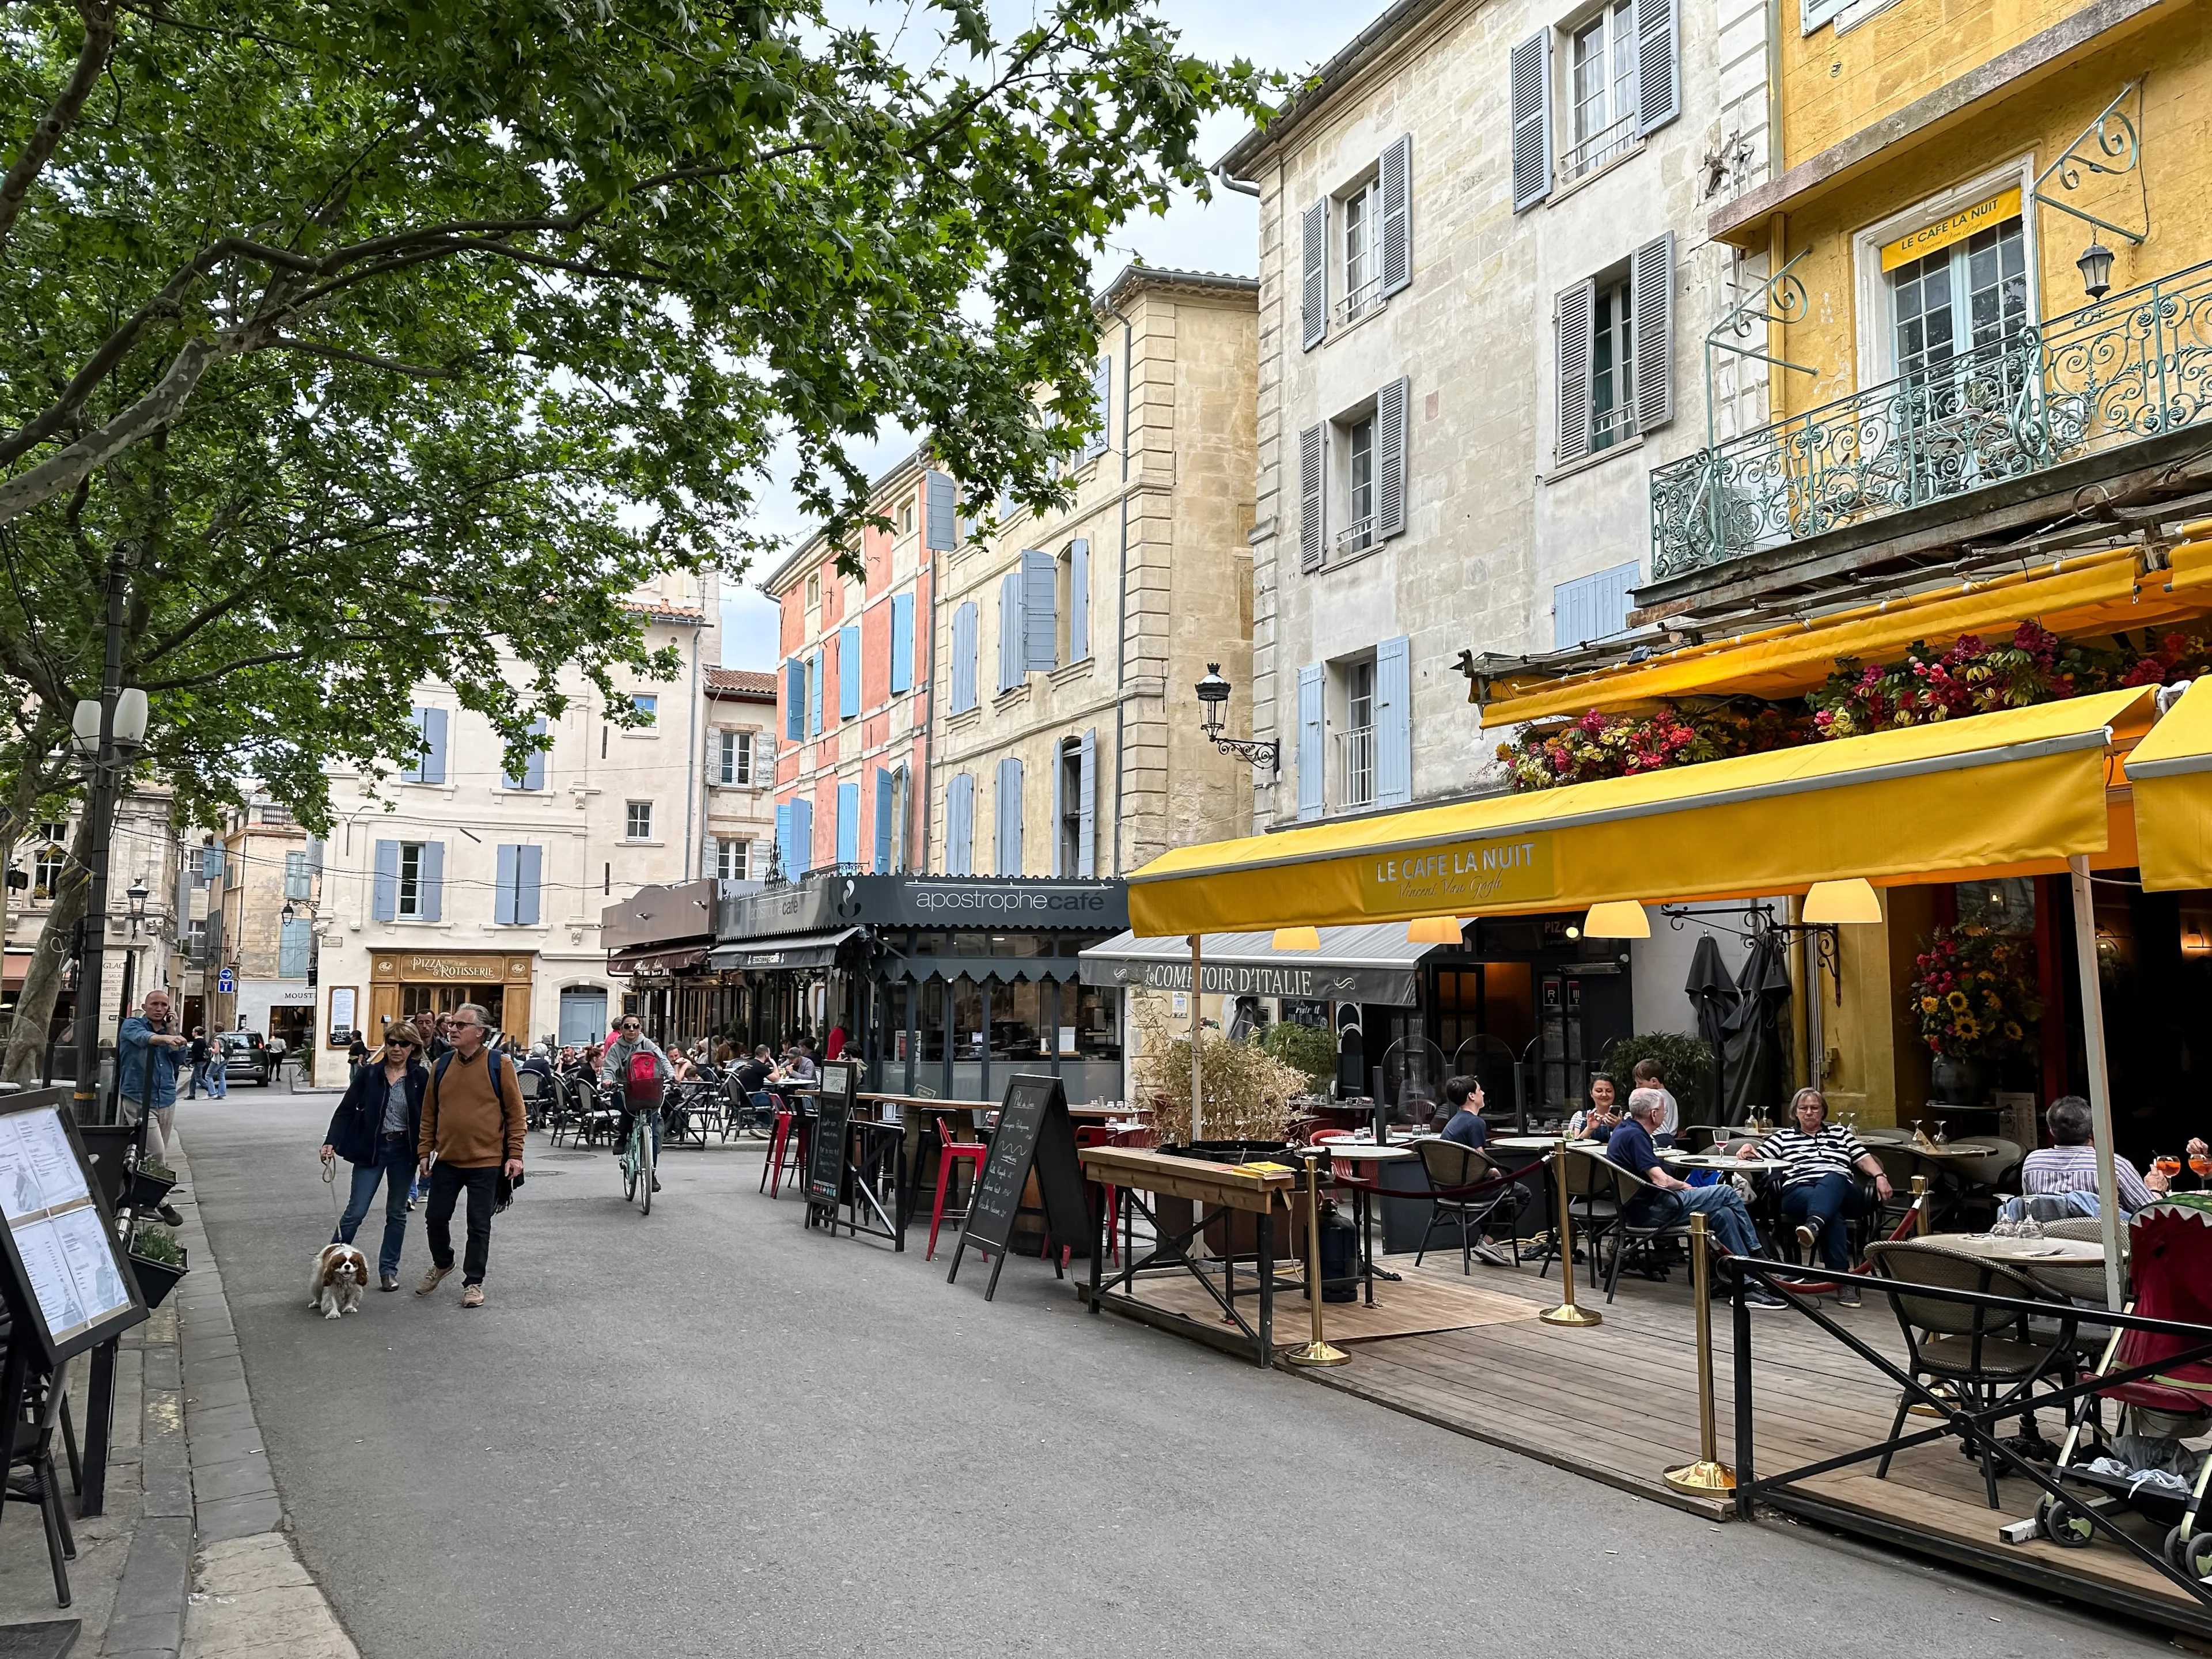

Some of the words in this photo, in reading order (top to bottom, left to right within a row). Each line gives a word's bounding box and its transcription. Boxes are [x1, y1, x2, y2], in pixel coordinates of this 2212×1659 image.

[1902, 237, 1914, 250] LE
[1918, 222, 1948, 243] CAFE
[1952, 214, 1967, 228] LA
[1971, 199, 1998, 219] NUIT
[1377, 861, 1397, 882] LE
[1402, 854, 1448, 880] CAFE
[1453, 850, 1478, 874] LA
[1482, 843, 1535, 870] NUIT
[1398, 881, 1438, 899] Vincent
[1441, 877, 1466, 895] Van
[1469, 868, 1503, 900] Gogh
[916, 890, 1104, 912] apostrophecafé
[411, 957, 442, 971] PIZZA
[440, 966, 495, 979] ROTISSERIE
[1239, 968, 1313, 995] D'ITALIE
